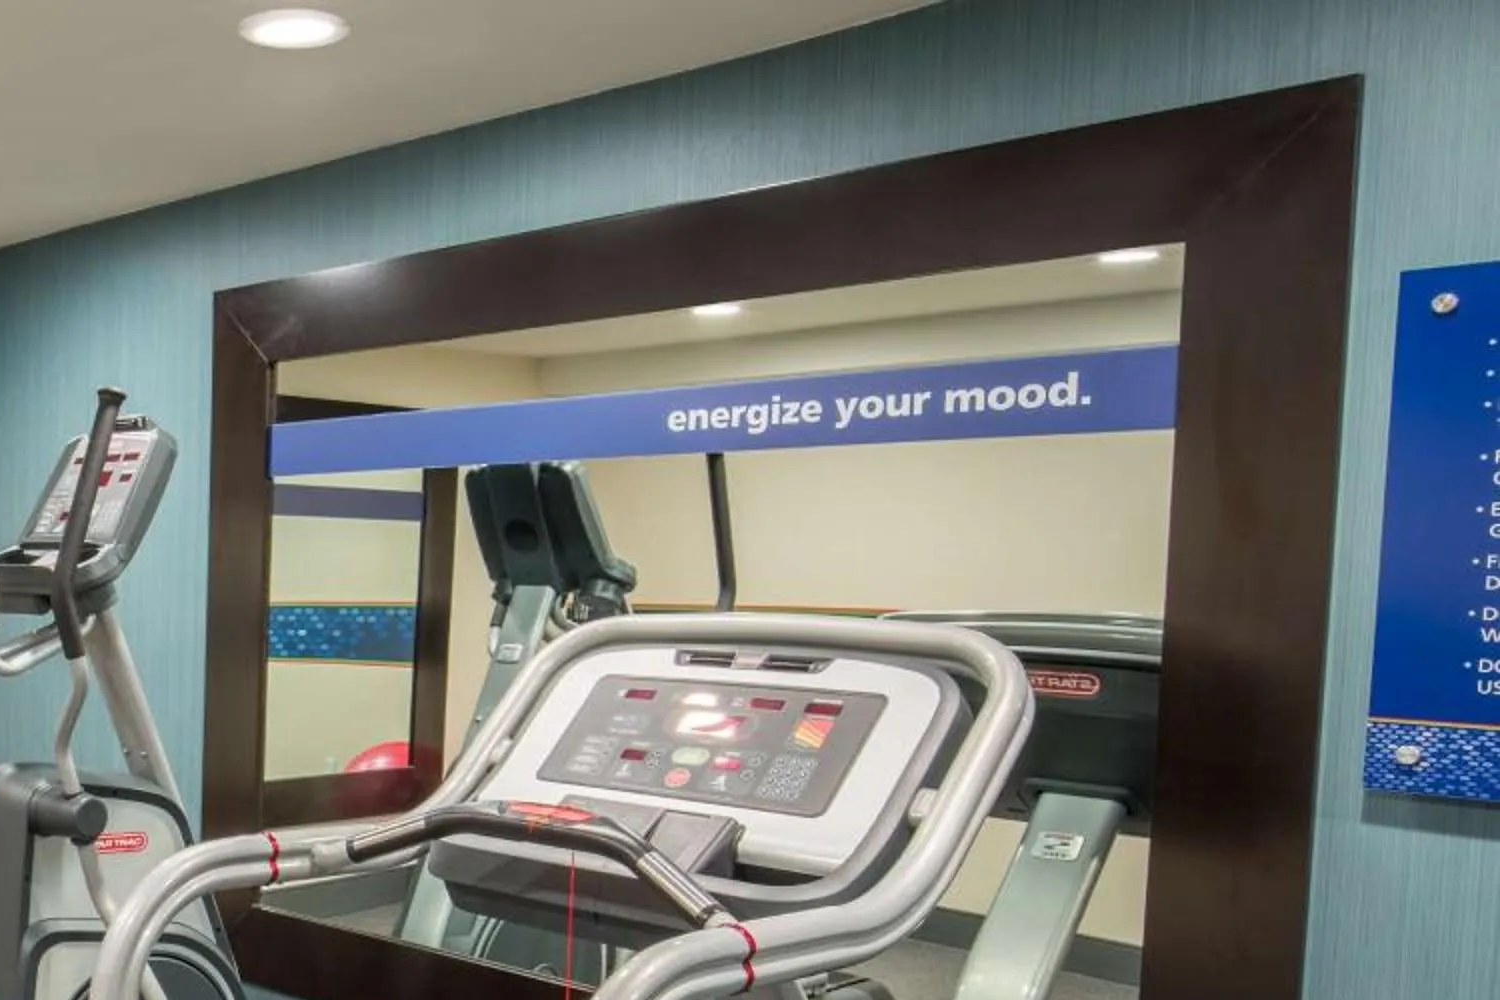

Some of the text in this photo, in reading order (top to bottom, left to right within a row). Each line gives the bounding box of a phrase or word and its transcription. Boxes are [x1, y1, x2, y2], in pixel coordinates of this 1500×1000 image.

[667, 371, 1091, 434] energize your mood.
